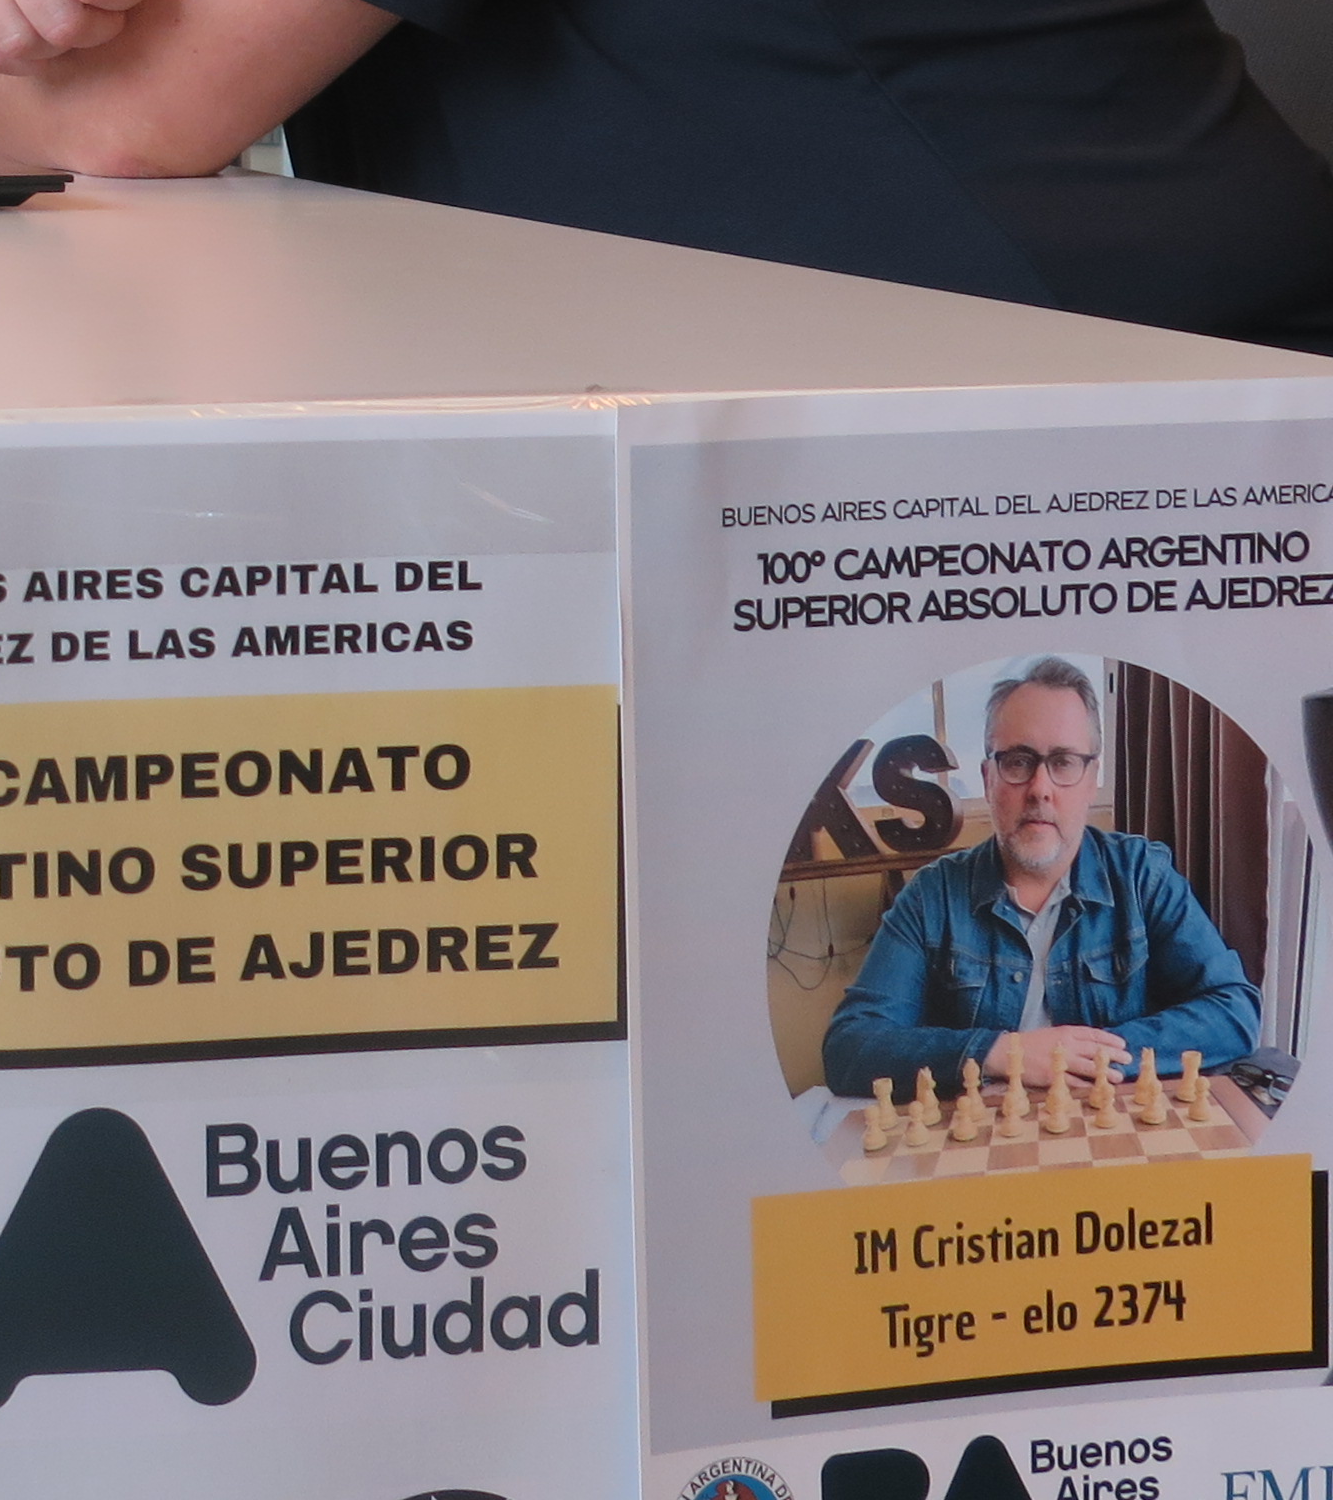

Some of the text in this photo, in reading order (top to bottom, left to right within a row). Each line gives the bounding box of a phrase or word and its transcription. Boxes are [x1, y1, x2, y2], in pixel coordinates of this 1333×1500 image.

[721, 503, 816, 528] BUENOS
[820, 499, 887, 523] AIRES
[892, 496, 990, 520] CAPITAL
[995, 494, 1042, 516] DEL
[1045, 489, 1150, 514] AJEDREZ
[1155, 488, 1188, 510] DE
[1193, 486, 1238, 508] LAS
[22, 567, 164, 603] AIRES
[179, 562, 379, 599] CAPITAL
[395, 560, 483, 593] DEL
[833, 538, 1092, 582] CAMPEONATO
[1097, 530, 1310, 570] ARGENTINO
[733, 591, 913, 632] SUPERIOR
[917, 582, 1118, 623] ABSOLUTO
[1127, 579, 1178, 614] DE
[51, 630, 111, 663] DE
[128, 627, 216, 661] LAS
[231, 619, 473, 658] AMERICAS
[180, 832, 539, 892] SUPERIOR
[128, 936, 216, 988] DE
[239, 922, 560, 982] AJEDREZ
[205, 1122, 527, 1198] Buenos
[258, 1203, 499, 1282] Aires
[853, 1201, 1213, 1275] IM Cristian Dolezal
[289, 1268, 600, 1366] Ciudad
[880, 1303, 976, 1359] Tigre
[1023, 1289, 1078, 1335] elo
[1093, 1279, 1187, 1328] 2374
[688, 1459, 776, 1494] ARGENTINA
[1030, 1436, 1173, 1474] Buenos
[1056, 1474, 1160, 1500] Aires
